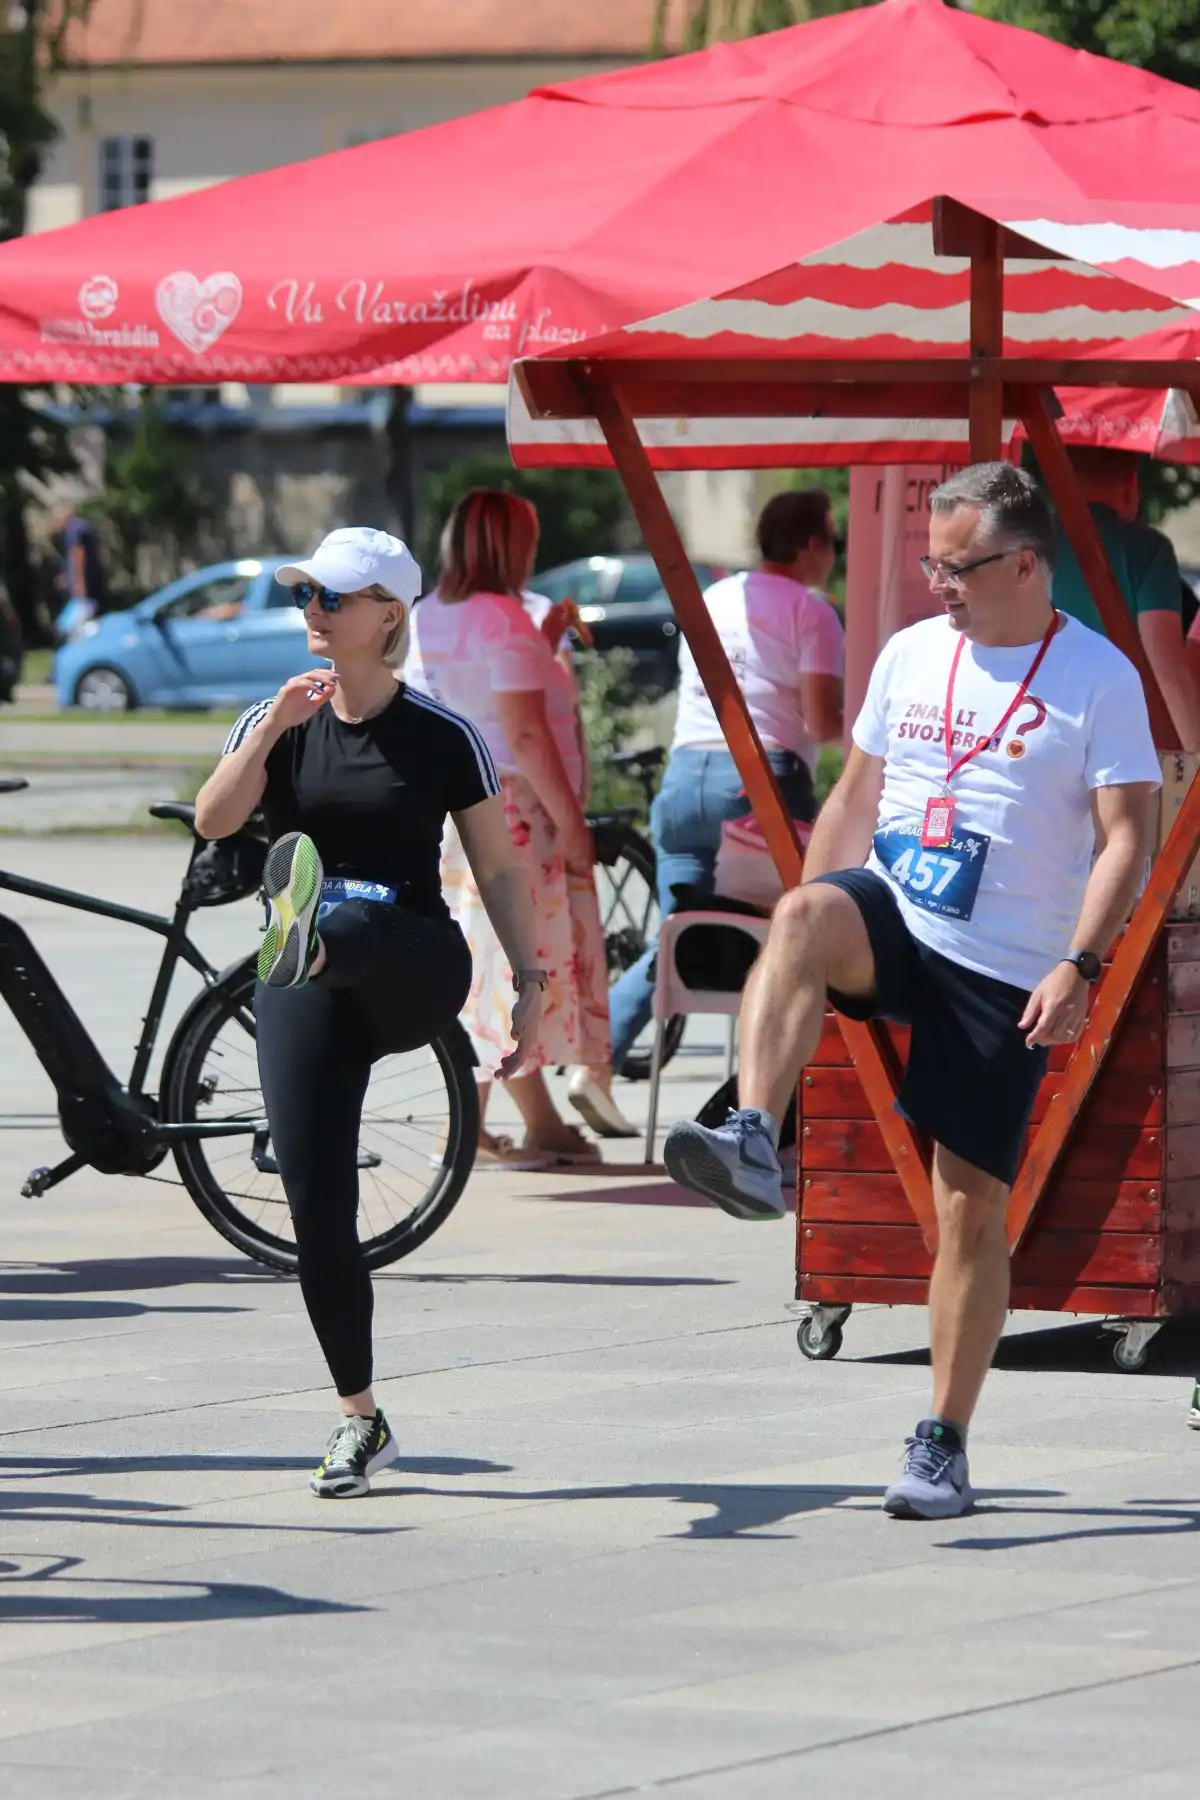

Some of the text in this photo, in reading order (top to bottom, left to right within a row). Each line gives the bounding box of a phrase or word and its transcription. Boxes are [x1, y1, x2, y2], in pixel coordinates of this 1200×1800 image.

[267, 278, 324, 323] Vu
[898, 721, 946, 743] SVOJ
[956, 709, 977, 727] LI
[890, 848, 962, 897] 457
